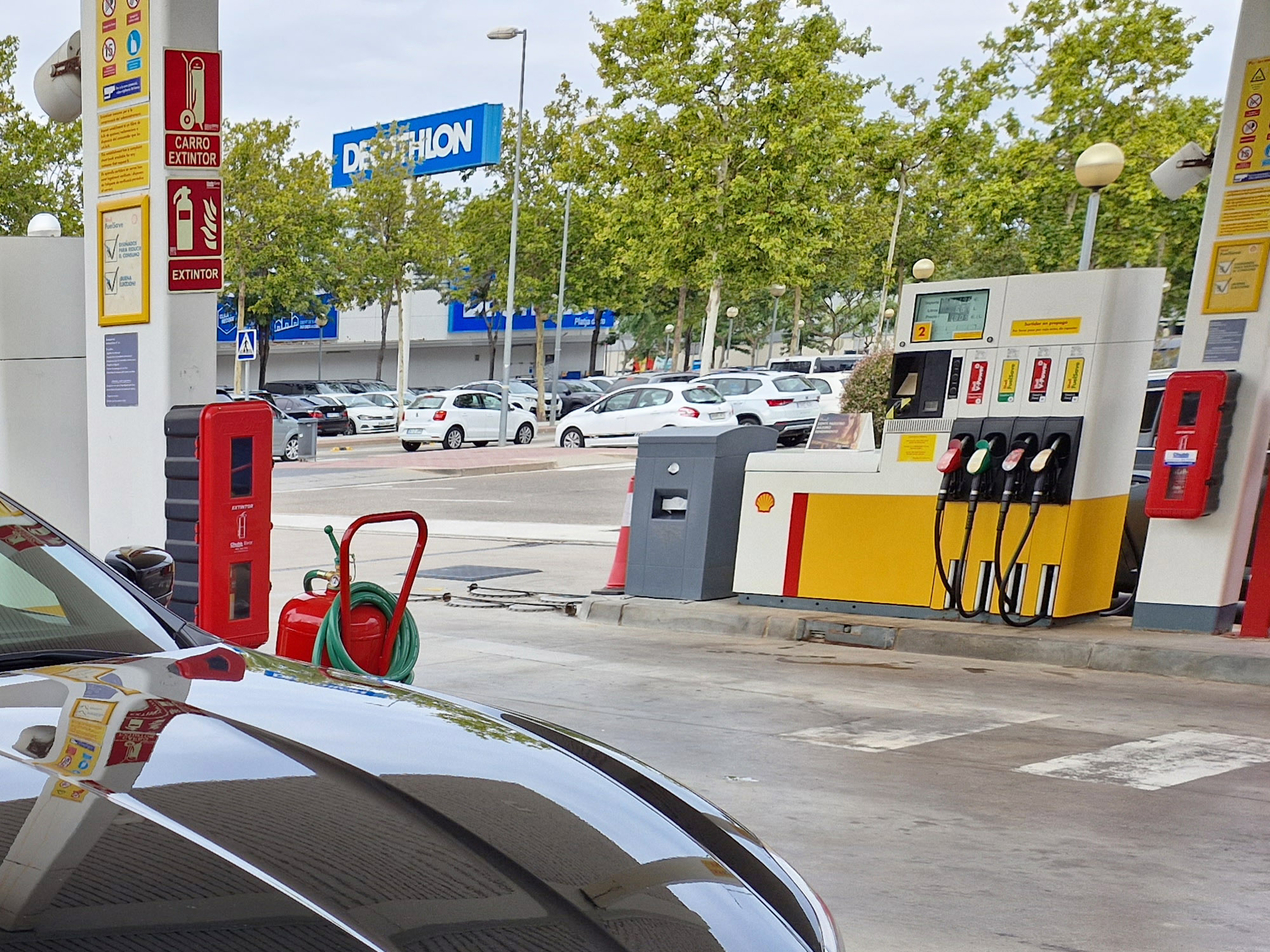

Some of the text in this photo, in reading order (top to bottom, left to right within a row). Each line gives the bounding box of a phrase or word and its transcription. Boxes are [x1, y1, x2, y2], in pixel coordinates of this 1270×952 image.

[174, 135, 210, 150] CARRO
[168, 151, 217, 166] EXTINTOR
[171, 268, 219, 281] EXTINTOR
[918, 326, 926, 337] 2
[1007, 364, 1016, 389] FuelSave
[1071, 362, 1080, 389] FuelSave
